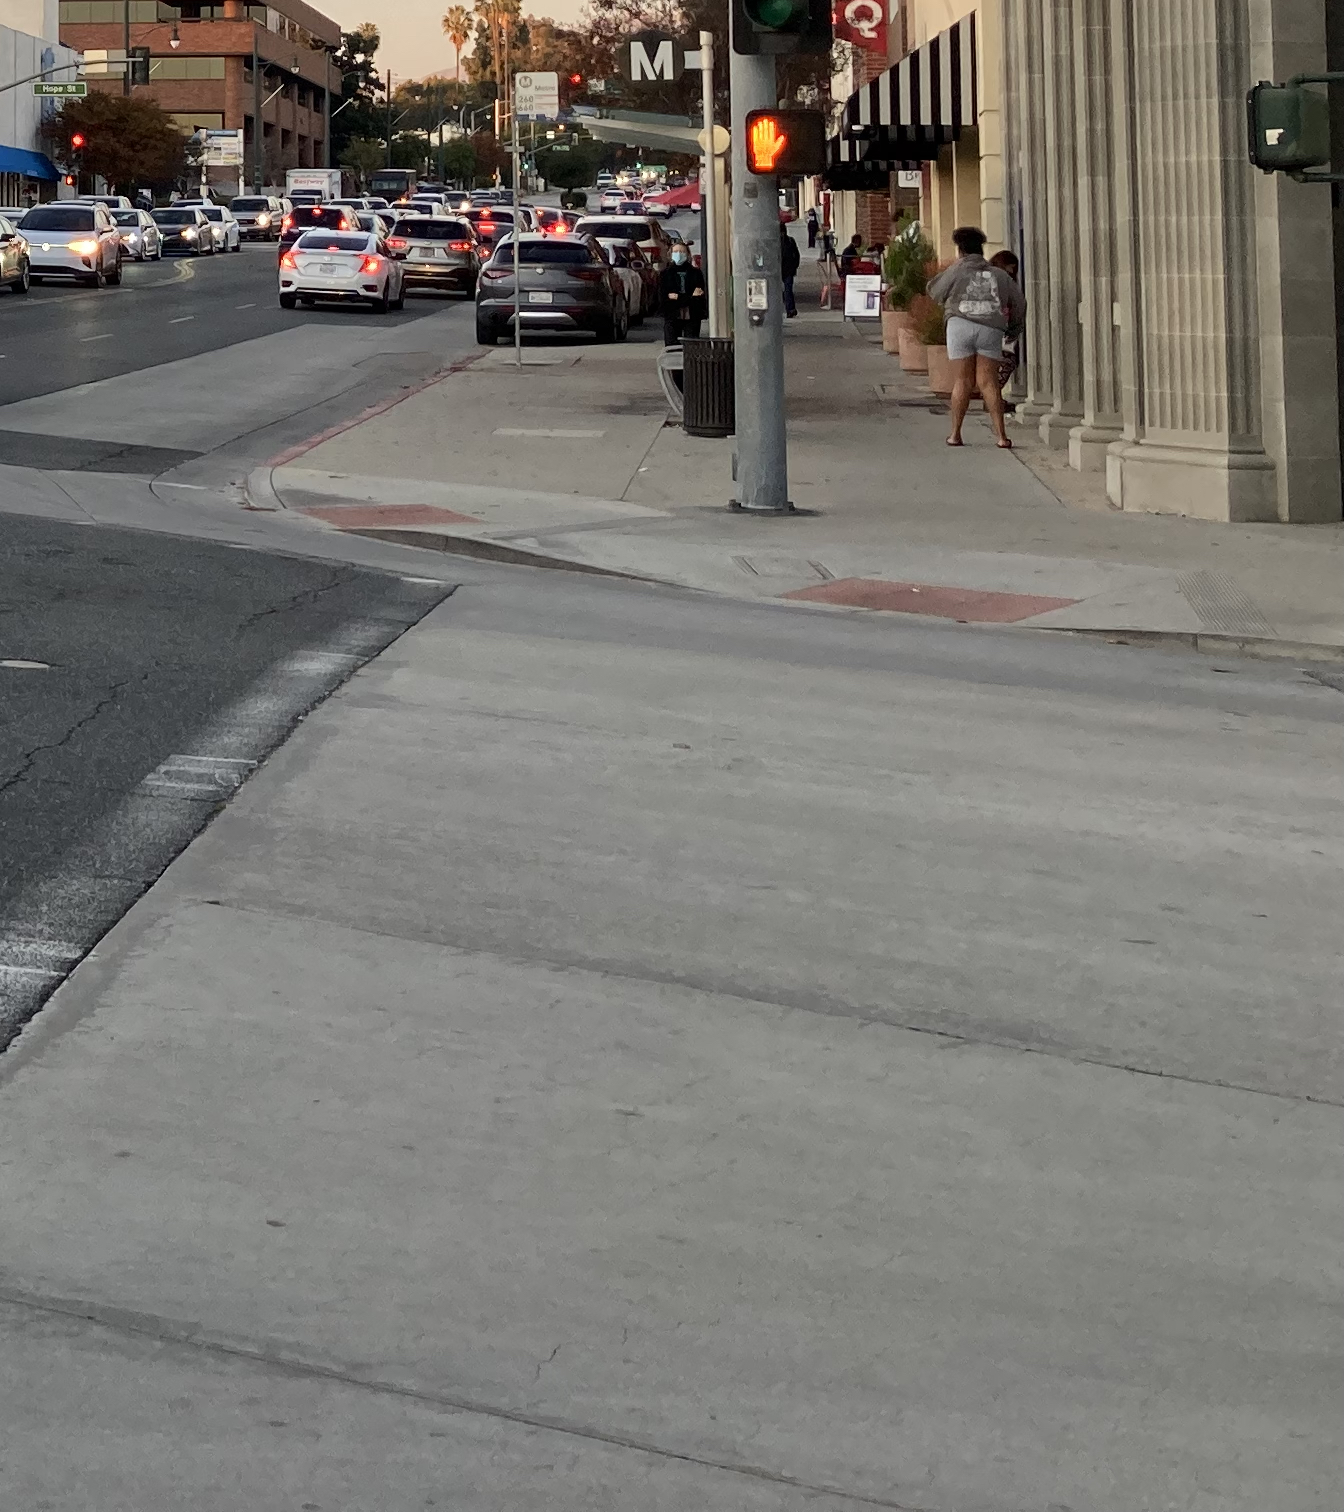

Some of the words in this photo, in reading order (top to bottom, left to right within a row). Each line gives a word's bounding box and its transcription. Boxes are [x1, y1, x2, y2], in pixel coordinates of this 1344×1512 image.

[630, 40, 674, 80] M
[42, 84, 63, 94] Hope
[66, 84, 77, 93] St
[518, 95, 534, 103] 260
